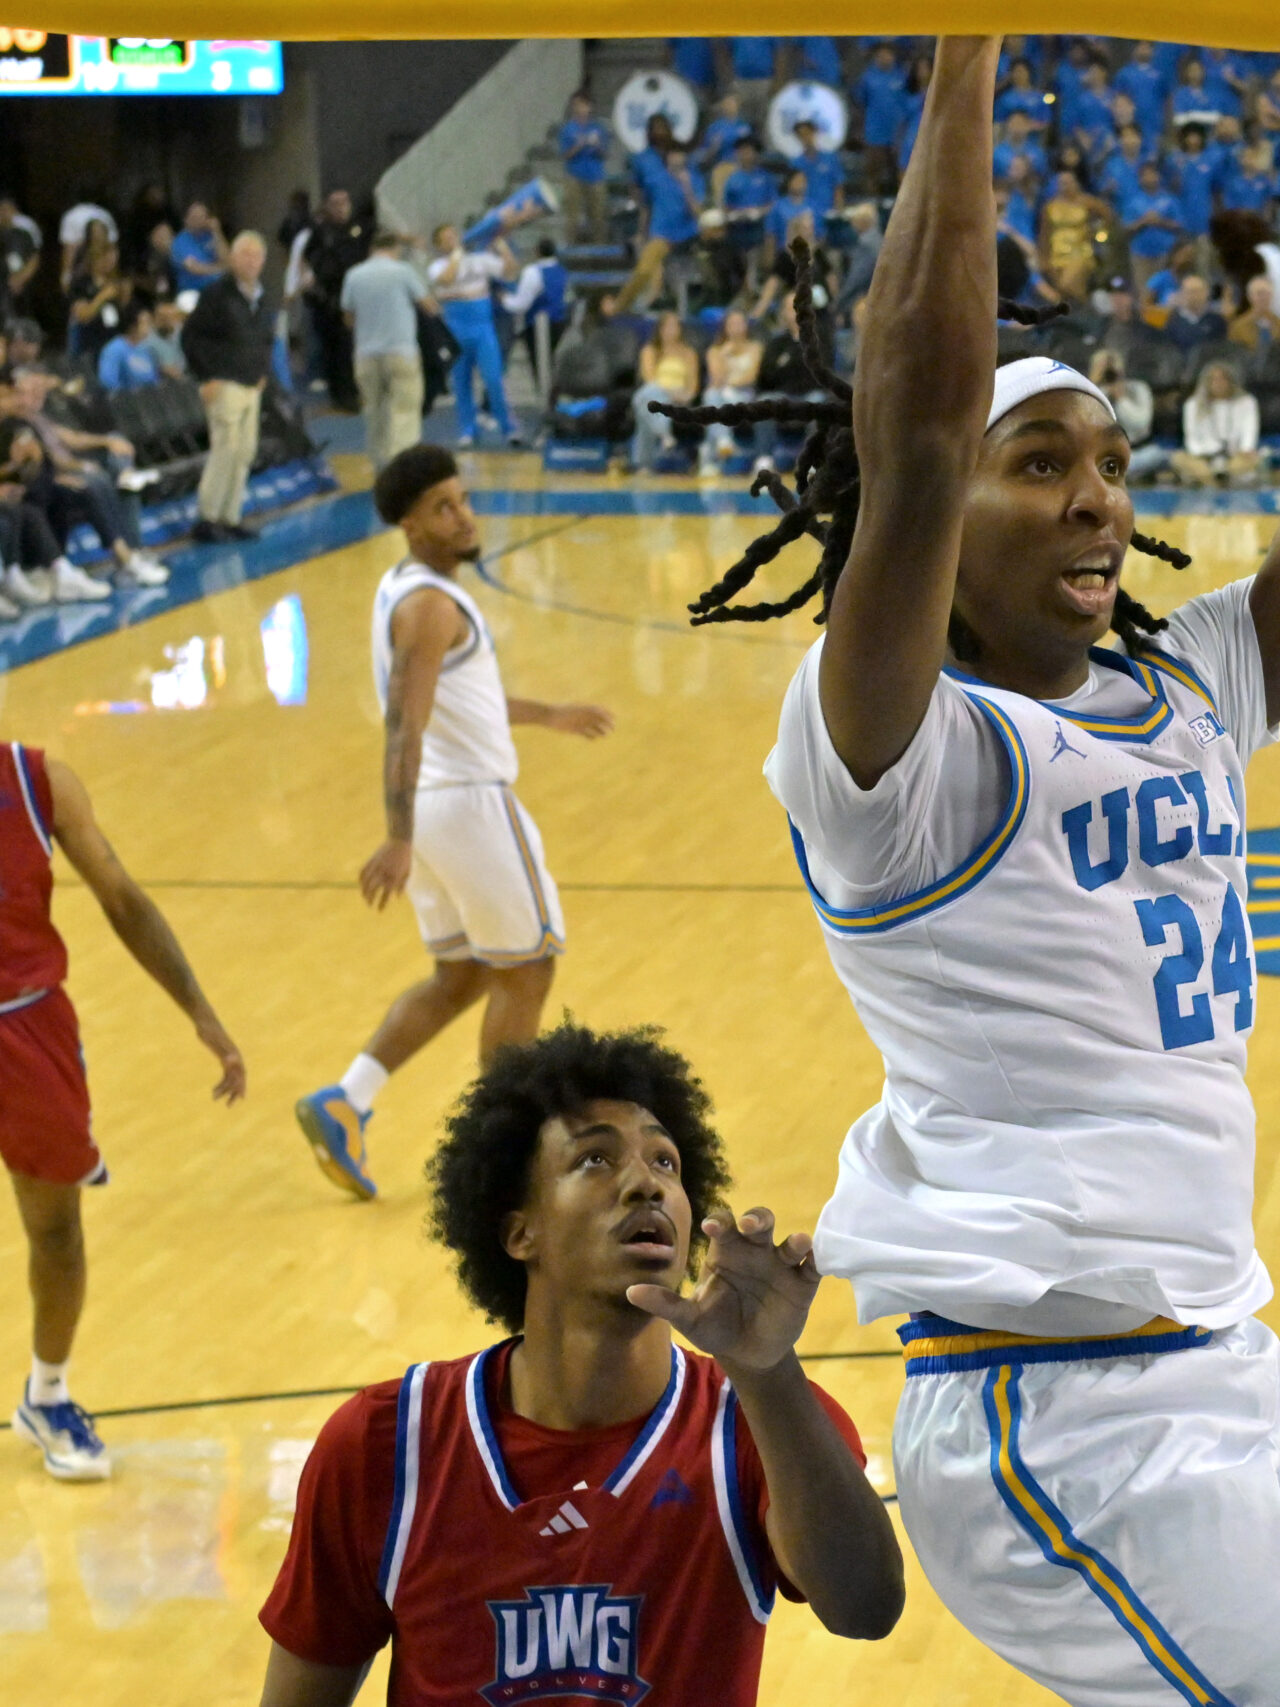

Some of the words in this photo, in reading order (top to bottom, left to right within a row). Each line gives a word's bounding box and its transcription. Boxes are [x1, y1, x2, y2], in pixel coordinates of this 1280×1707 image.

[1133, 882, 1254, 1051] 24
[499, 1592, 631, 1680] UWG
[503, 1675, 631, 1697] WOLVES
